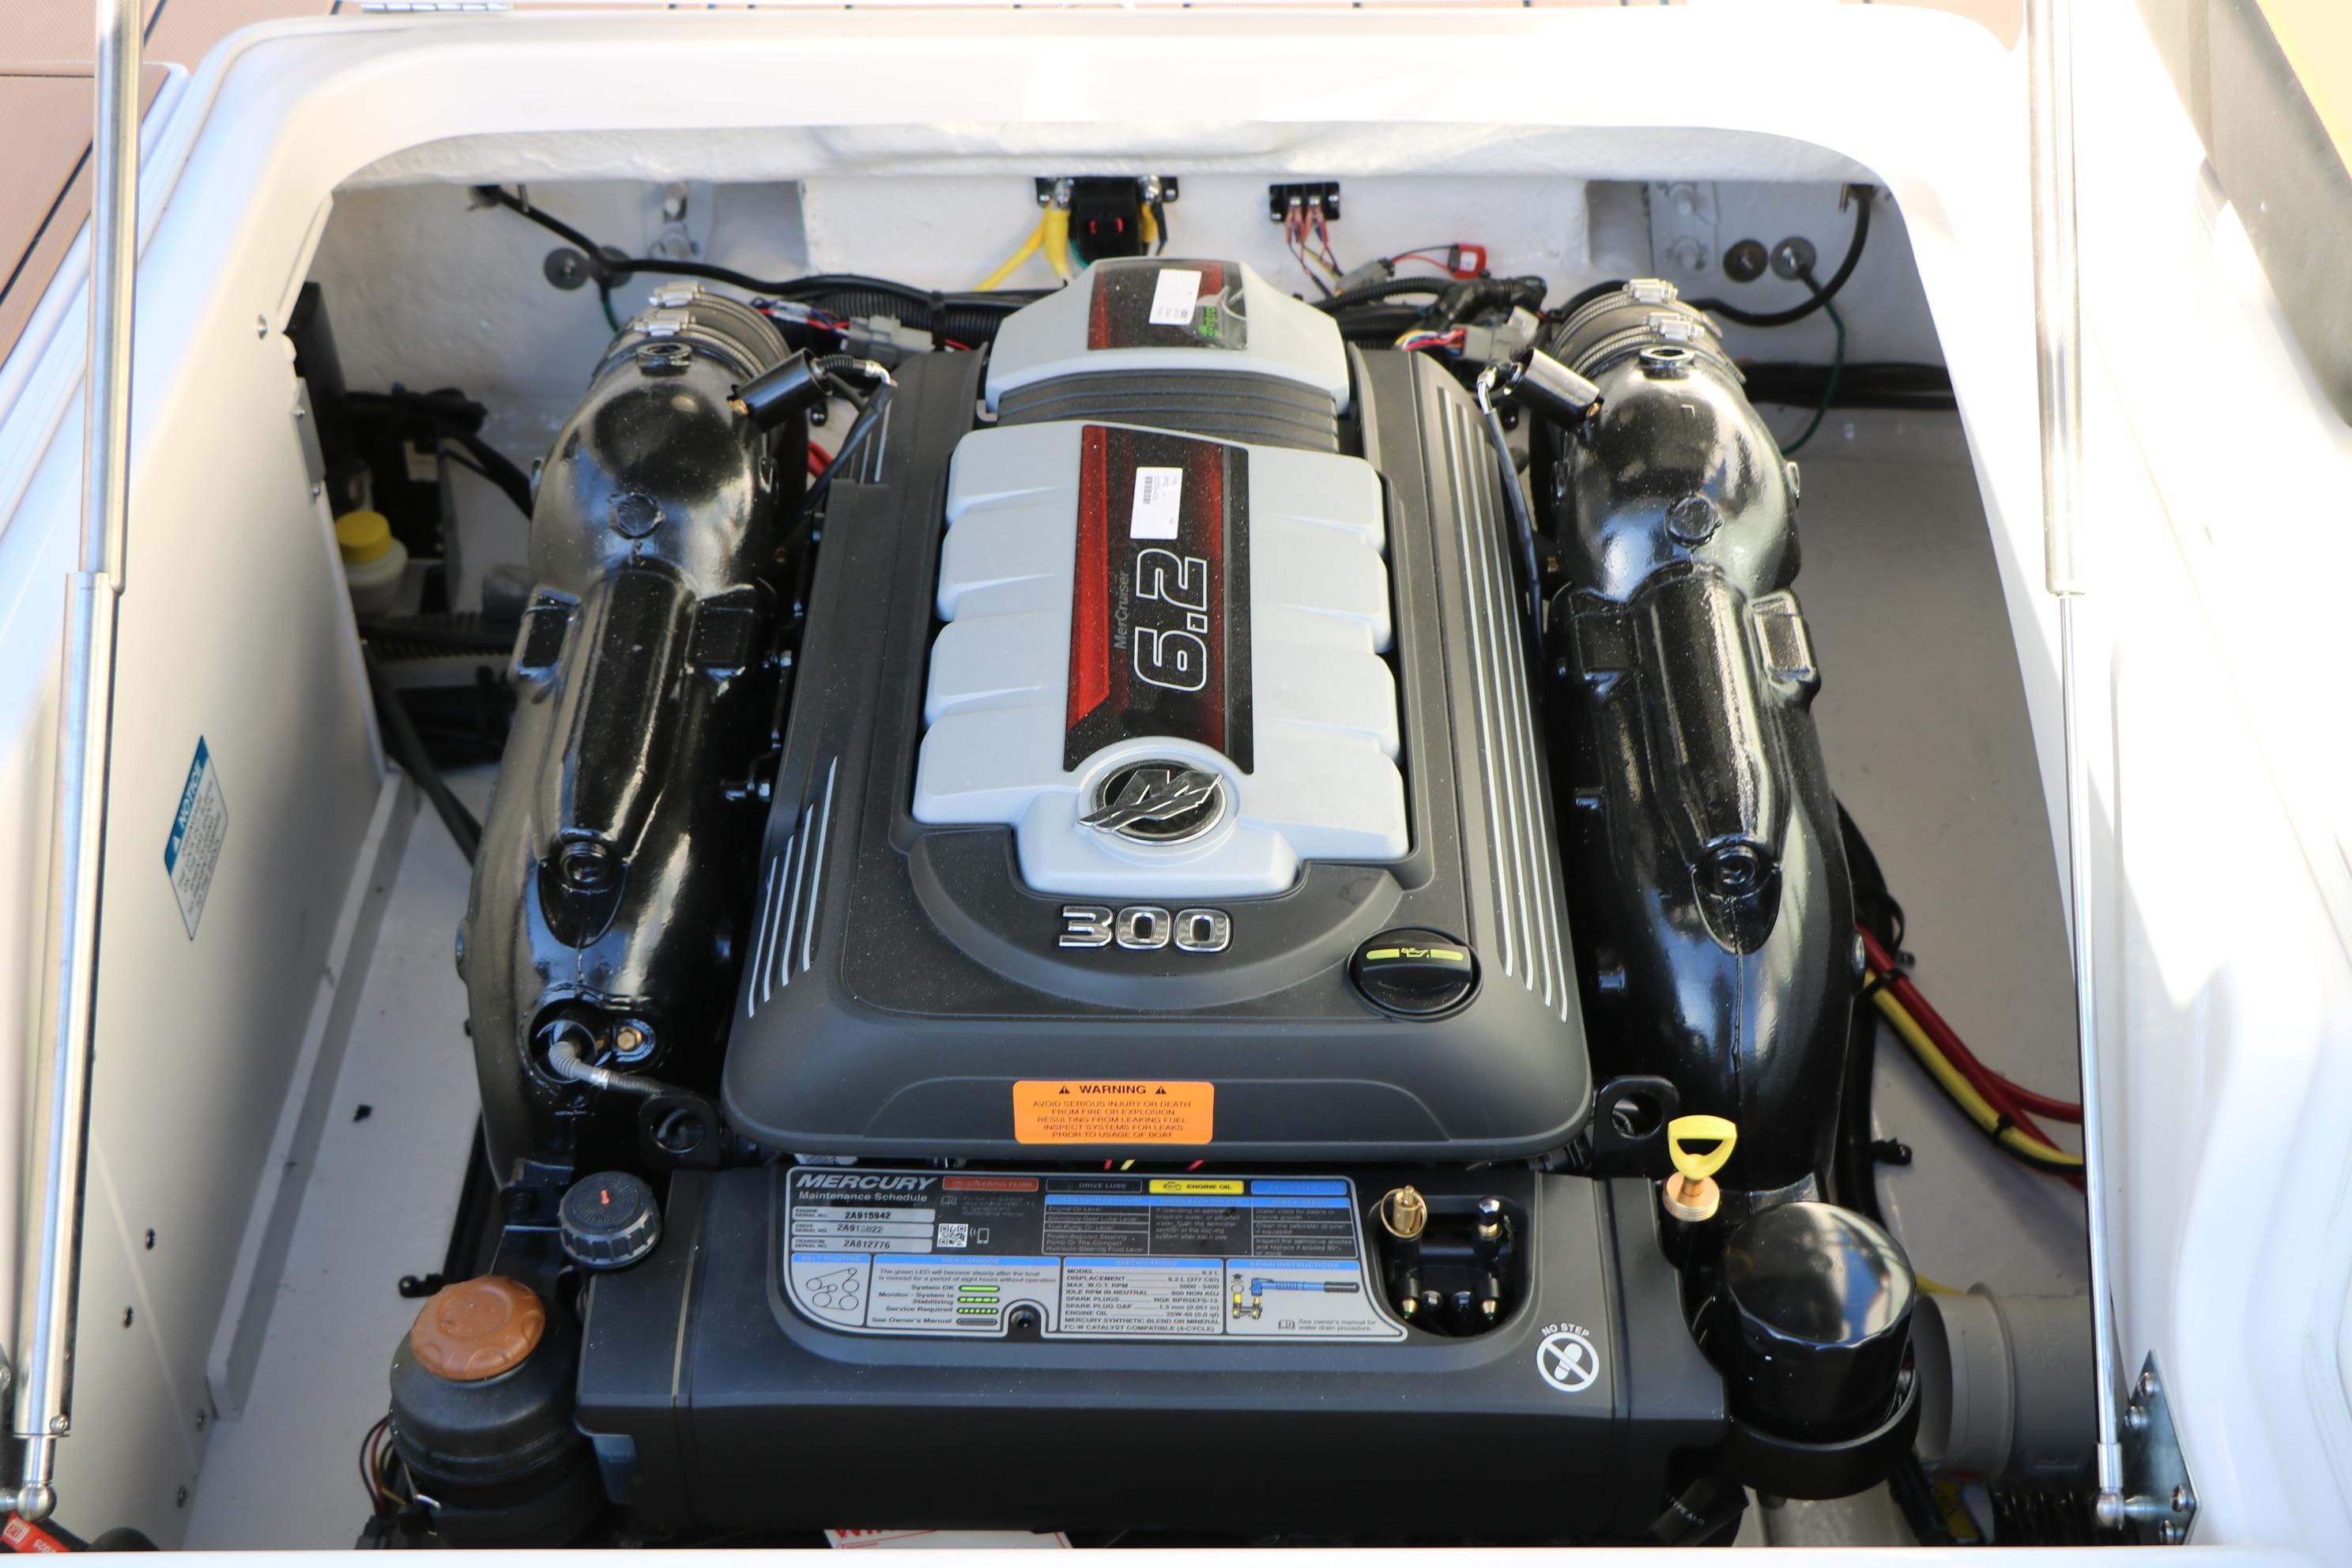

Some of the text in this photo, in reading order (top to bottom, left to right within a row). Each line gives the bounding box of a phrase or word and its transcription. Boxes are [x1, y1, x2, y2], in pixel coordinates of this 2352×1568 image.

[1114, 570, 1130, 650] MerCruiser
[1133, 548, 1208, 692] 6.2
[179, 759, 202, 829] NOTICE
[1058, 906, 1232, 952] 300
[1080, 1085, 1146, 1094] WARNING
[797, 1174, 938, 1190] MERCURY
[799, 1191, 928, 1202] Maintenance Schedule
[843, 1239, 890, 1249] 2A812776
[1541, 1322, 1589, 1336] NO STEP
